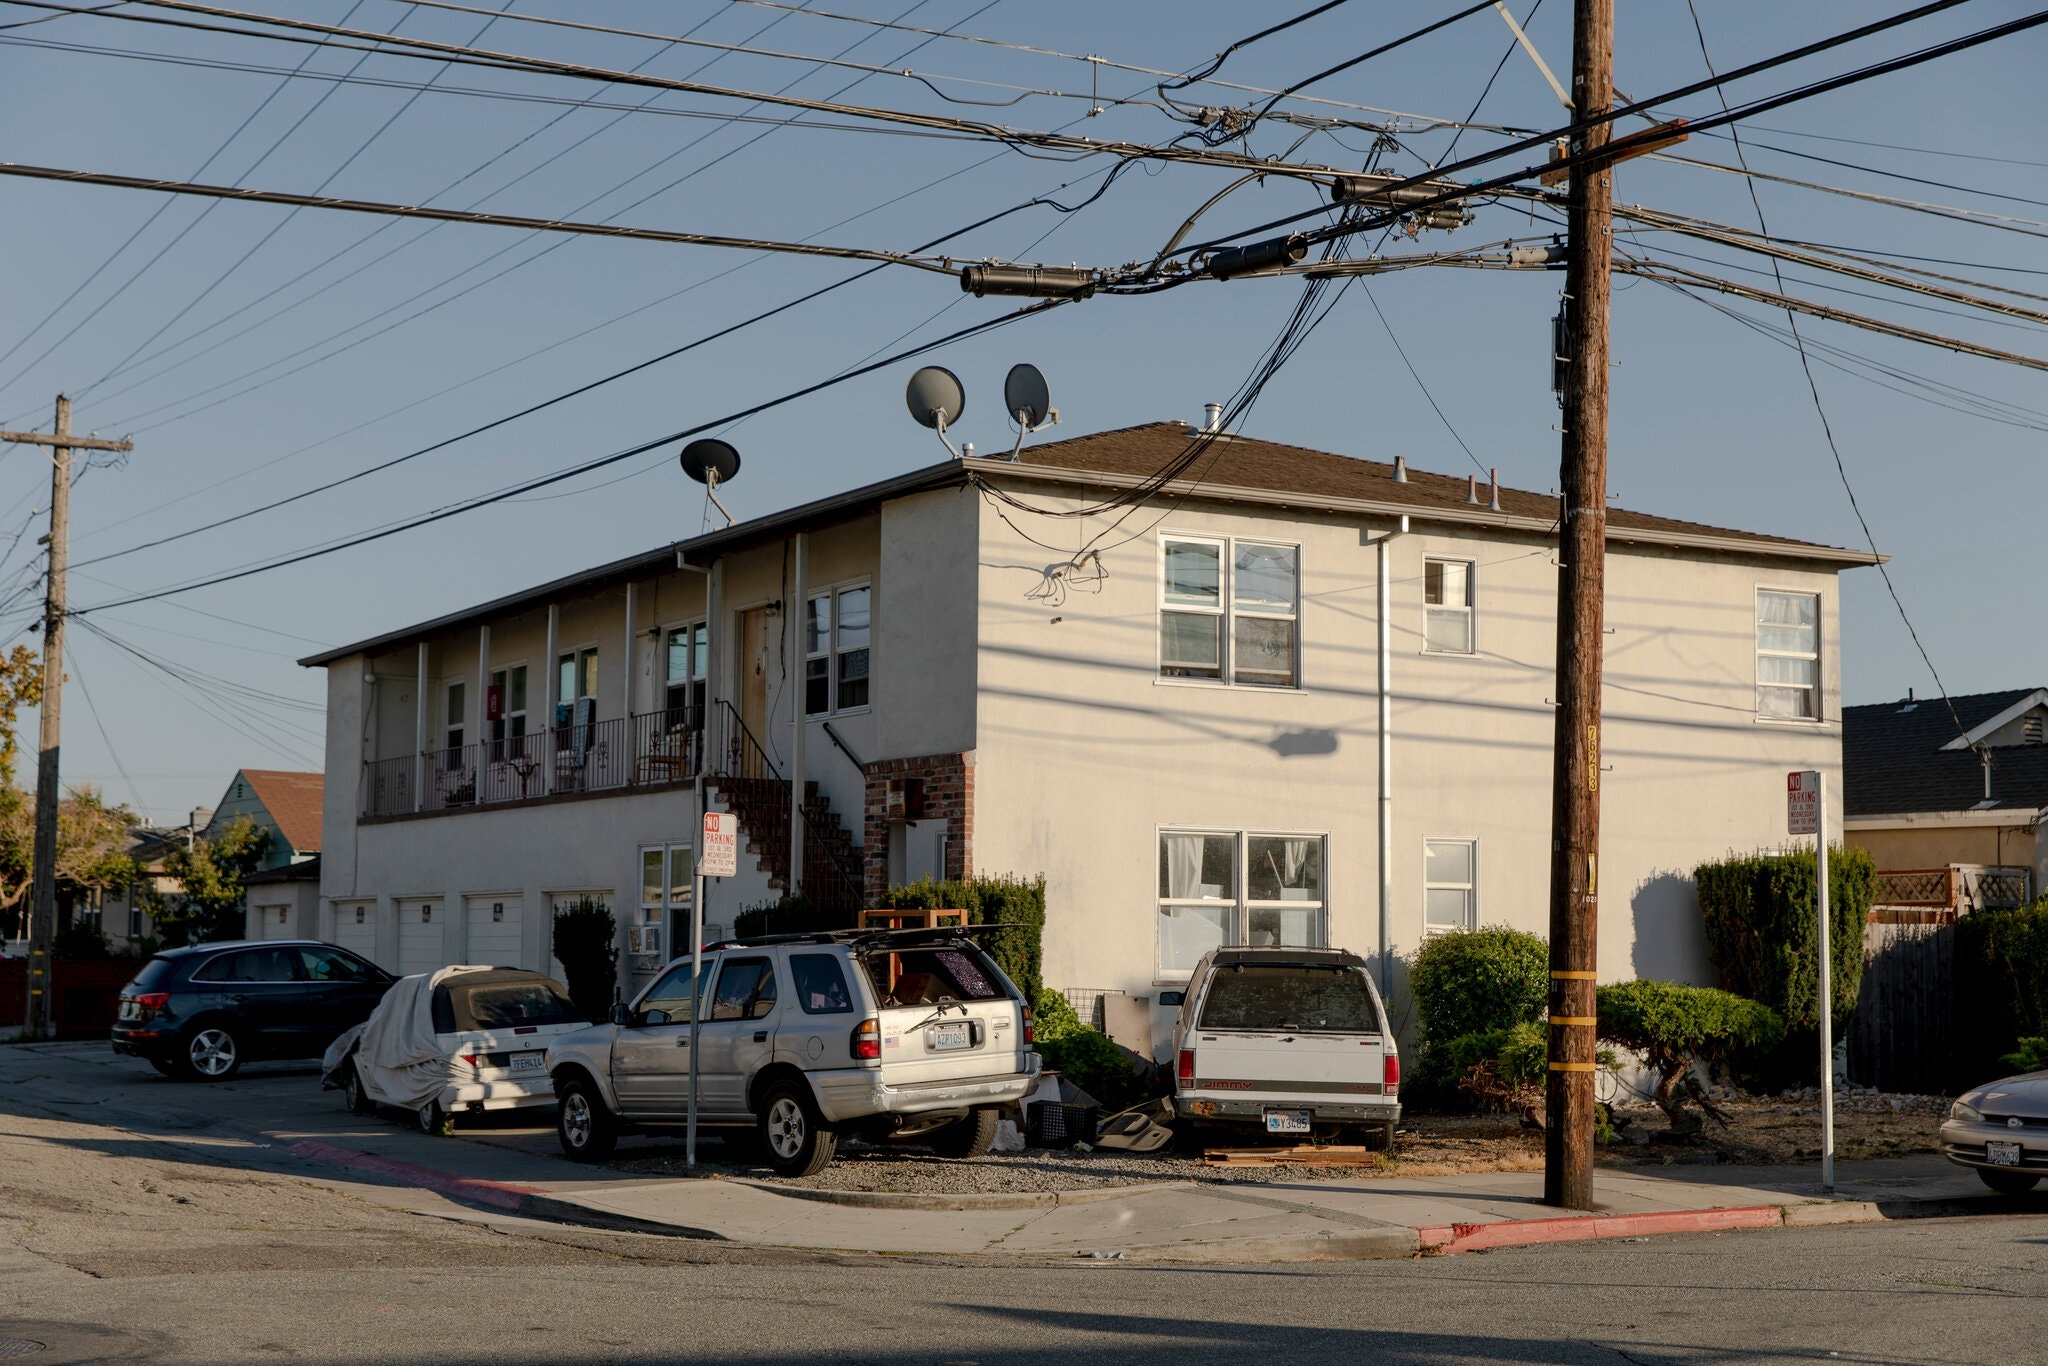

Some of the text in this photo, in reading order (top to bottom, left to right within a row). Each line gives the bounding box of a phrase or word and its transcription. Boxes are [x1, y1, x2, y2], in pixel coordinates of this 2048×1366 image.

[1790, 775, 1801, 789] NO
[1789, 791, 1816, 803] PARKING
[707, 816, 719, 830] NO
[706, 832, 734, 846] PARKING
[1203, 1080, 1253, 1089] JIMMY
